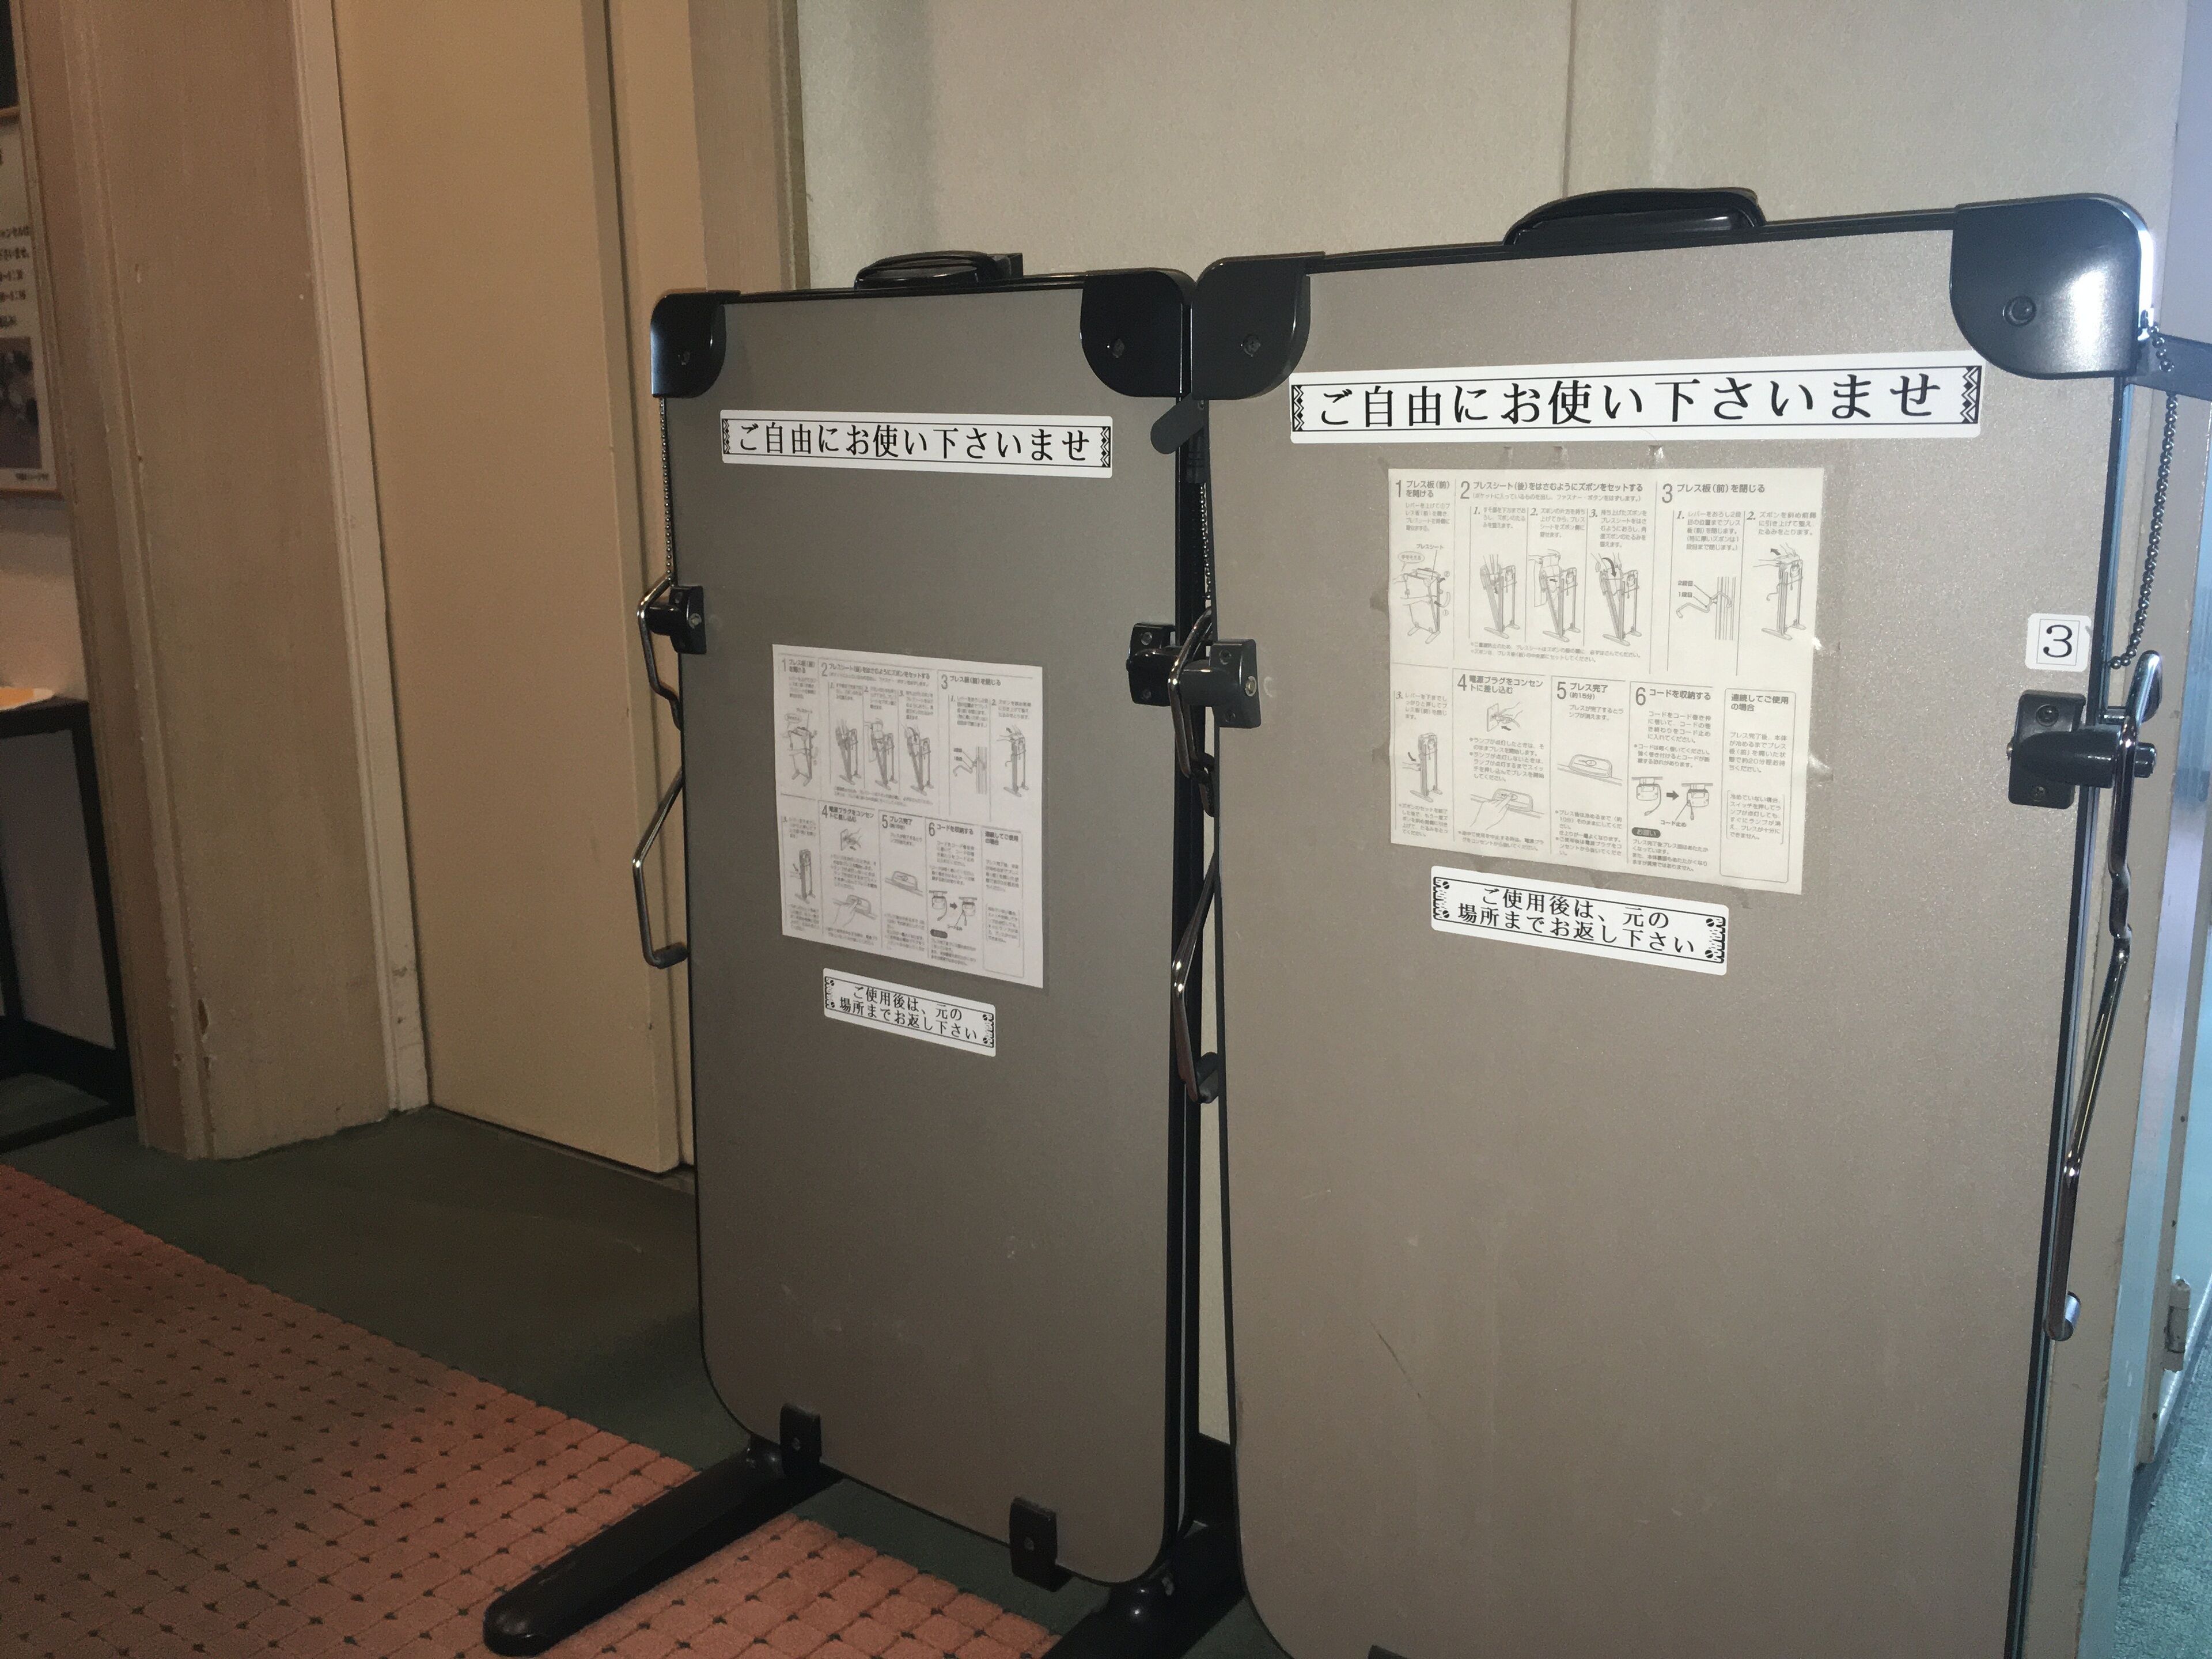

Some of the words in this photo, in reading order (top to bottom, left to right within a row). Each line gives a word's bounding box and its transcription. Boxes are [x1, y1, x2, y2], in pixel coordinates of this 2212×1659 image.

[1321, 374, 1940, 426] ご自由にお使い下さいませ
[740, 422, 1089, 461] ご自由にお使い下さいませ
[1406, 490, 1434, 498] を開ける
[1460, 481, 1470, 499] 2
[1662, 483, 1673, 503] 3
[1677, 484, 1765, 493] プレス板（前）を閉じる
[2043, 624, 2073, 658] 3
[1457, 674, 1467, 691] 4
[1469, 675, 1543, 687] 電源プラグをコンセン
[1470, 684, 1513, 694] トに差し込む
[1570, 683, 1608, 693] プレス完了
[1557, 682, 1566, 699] 5
[1635, 687, 1646, 705] 6
[1649, 689, 1711, 700] コードを収納する
[1731, 694, 1789, 704] 連続してご使用
[1731, 703, 1755, 711] の場合
[1482, 888, 1669, 929] ご使用後は、元の
[1458, 903, 1694, 953] 場所までお返し下さい
[854, 986, 961, 1021] ご使用後は、元の
[840, 997, 976, 1039] 場所までお返し下さい
